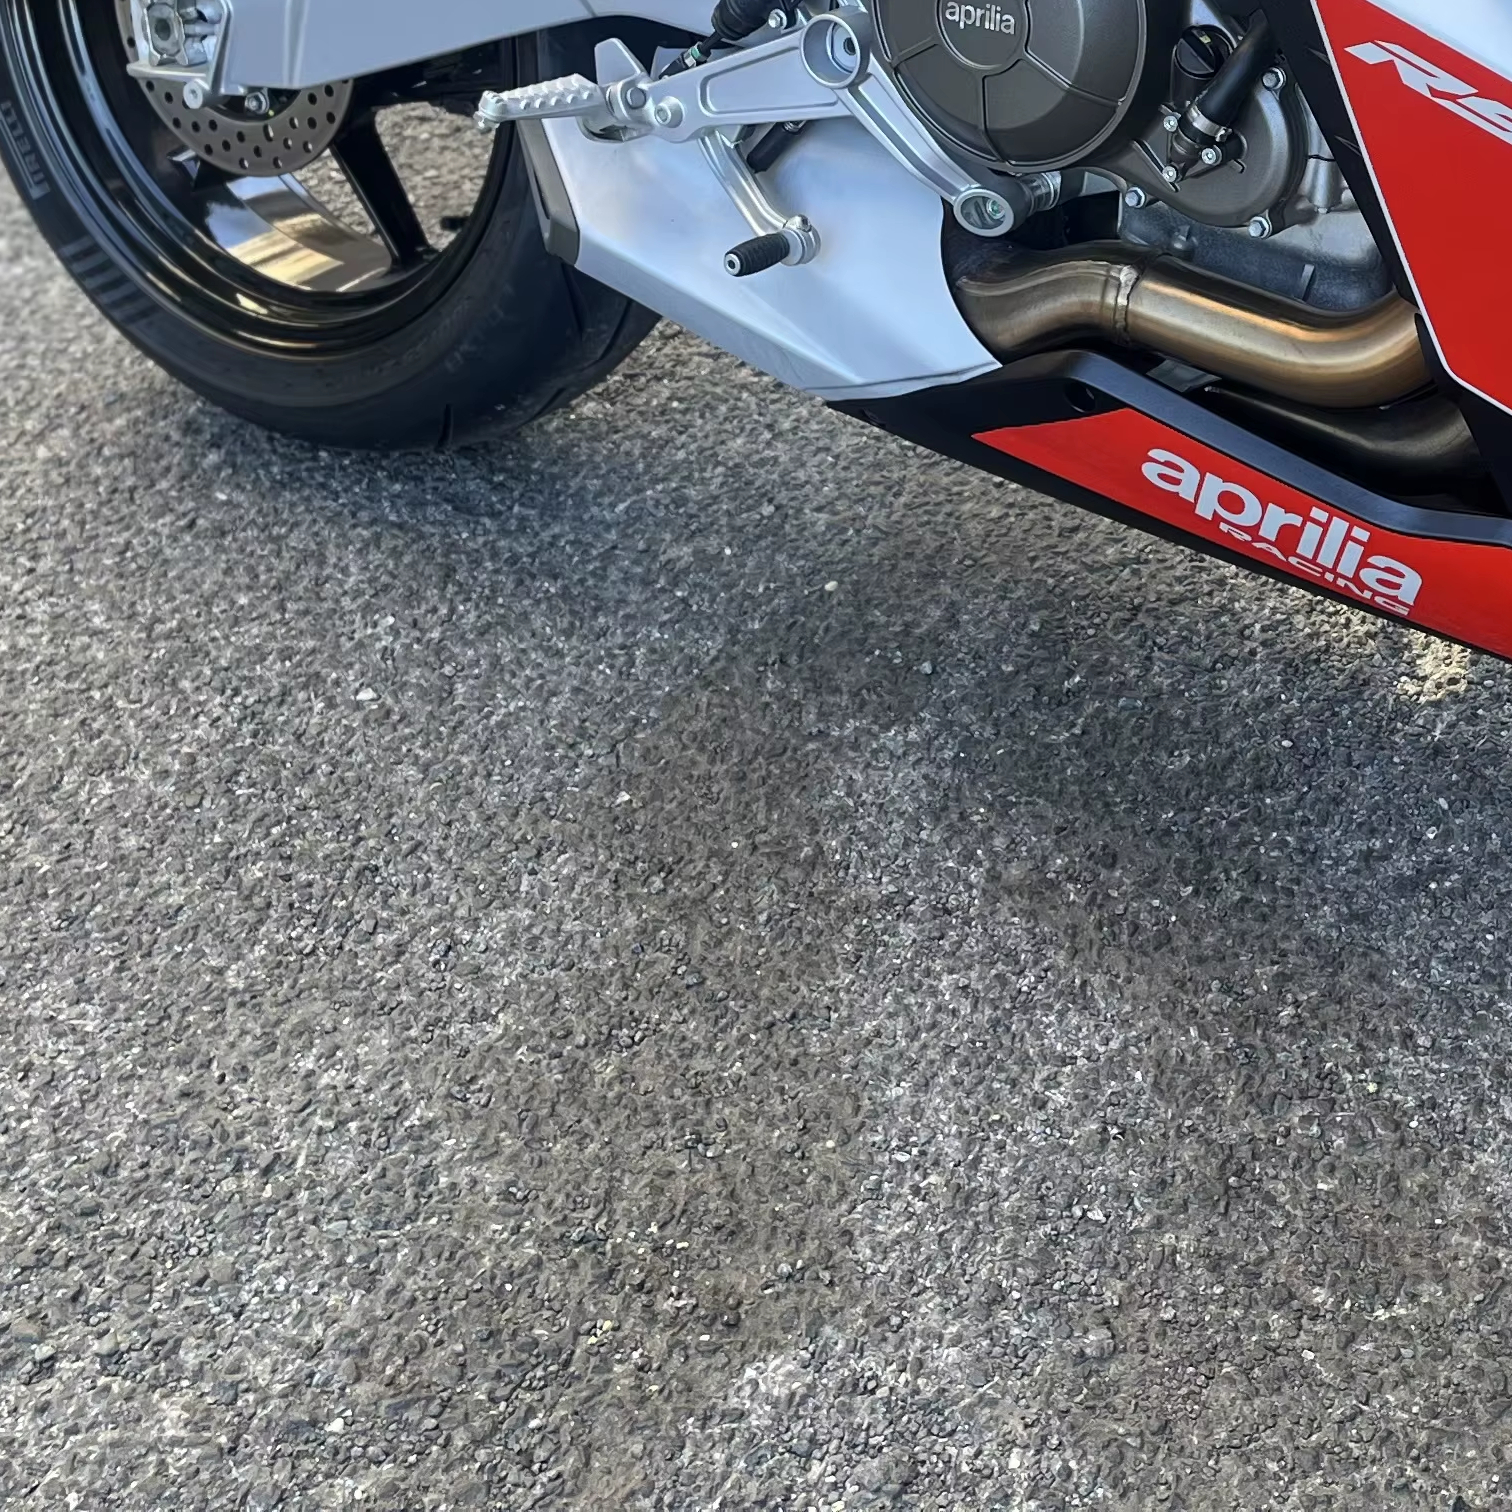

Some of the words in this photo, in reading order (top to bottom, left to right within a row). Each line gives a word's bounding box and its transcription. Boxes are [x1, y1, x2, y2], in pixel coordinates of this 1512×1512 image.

[945, 1, 1015, 35] aprilia
[1141, 449, 1423, 606] aprilia
[1219, 522, 1411, 616] RACING
